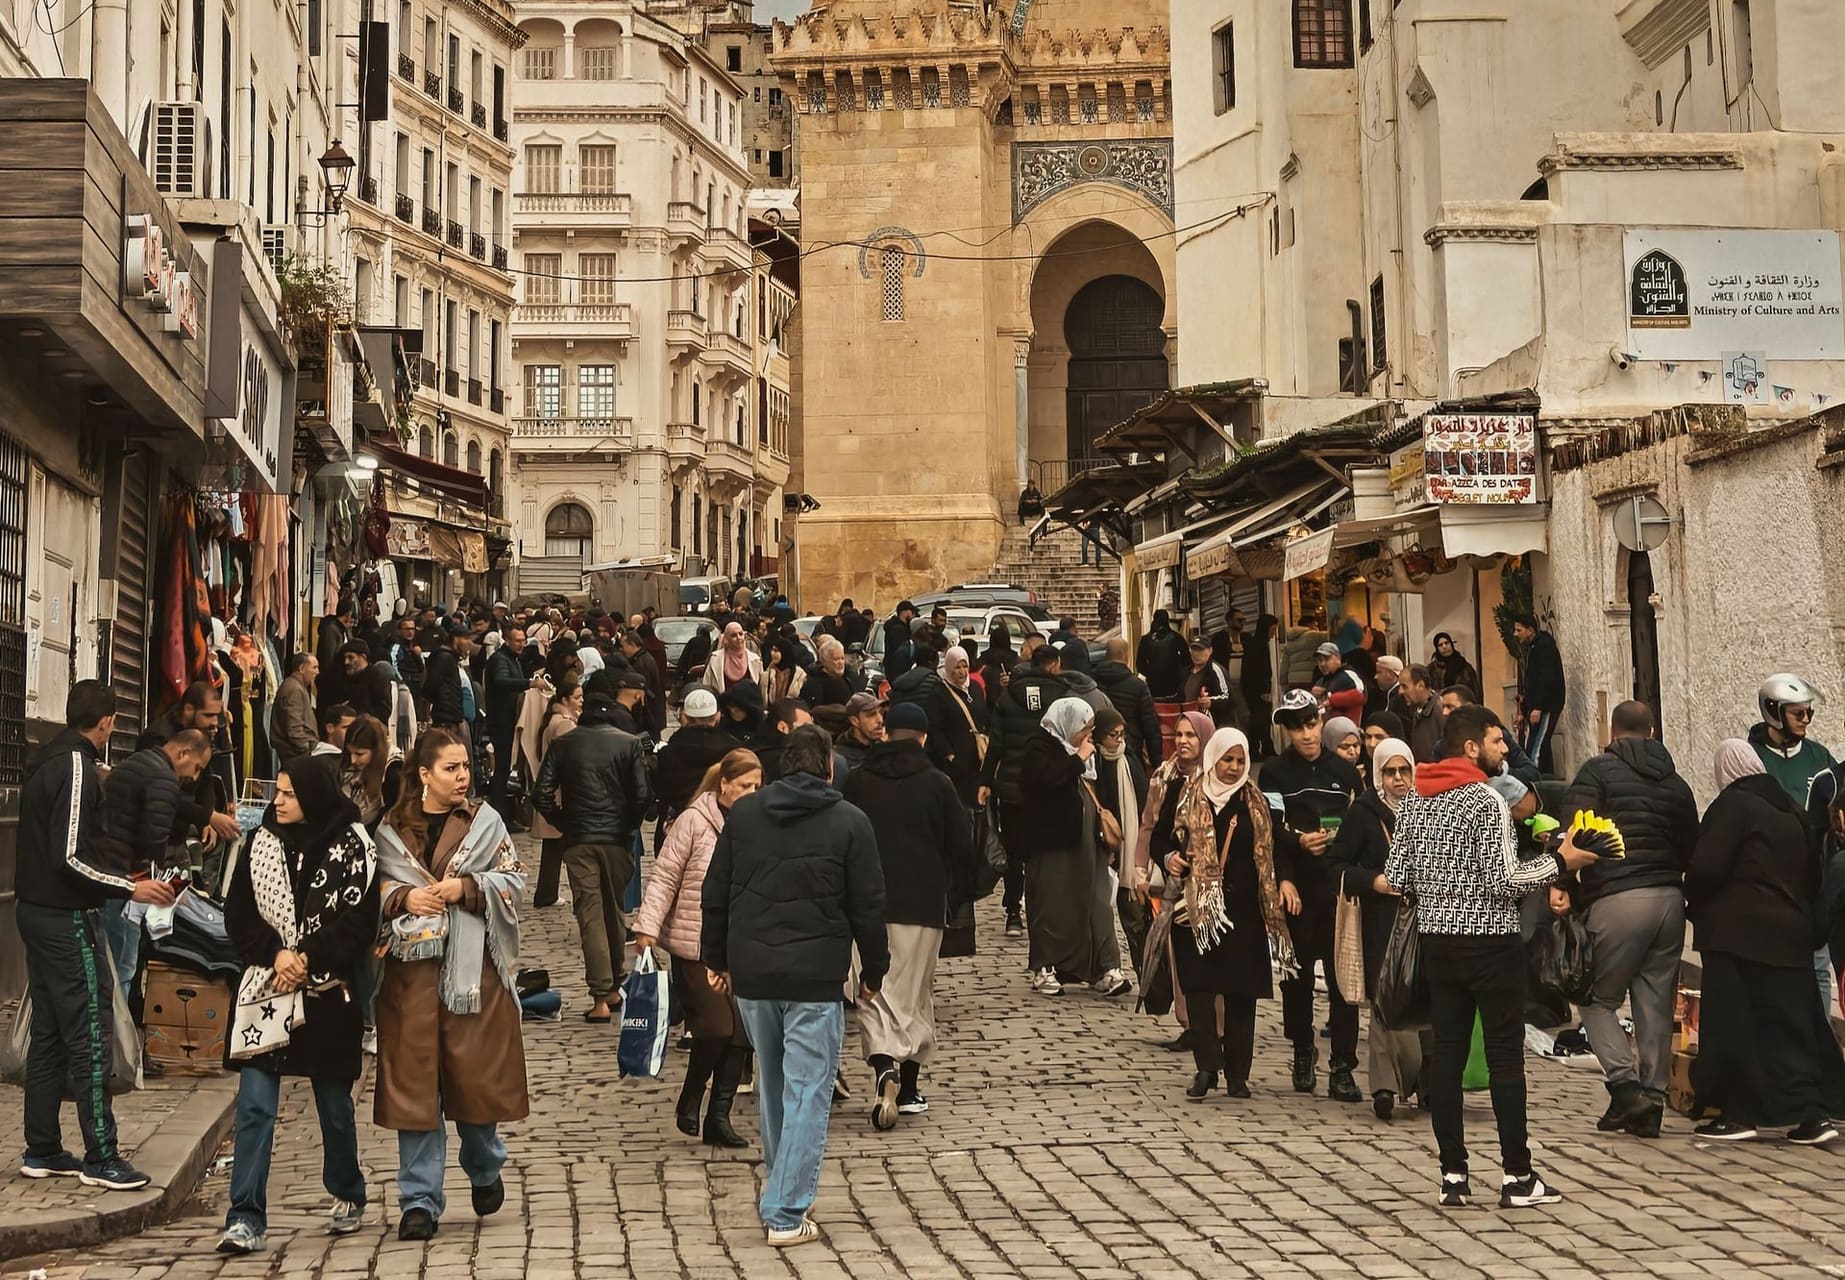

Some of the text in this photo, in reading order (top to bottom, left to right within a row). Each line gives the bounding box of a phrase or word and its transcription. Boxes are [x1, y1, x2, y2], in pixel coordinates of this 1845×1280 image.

[1708, 274, 1820, 289] وزارة الثقافة و الفنون
[1694, 305, 1840, 316] Ministry of Culture and Arts
[1482, 479, 1496, 488] DES
